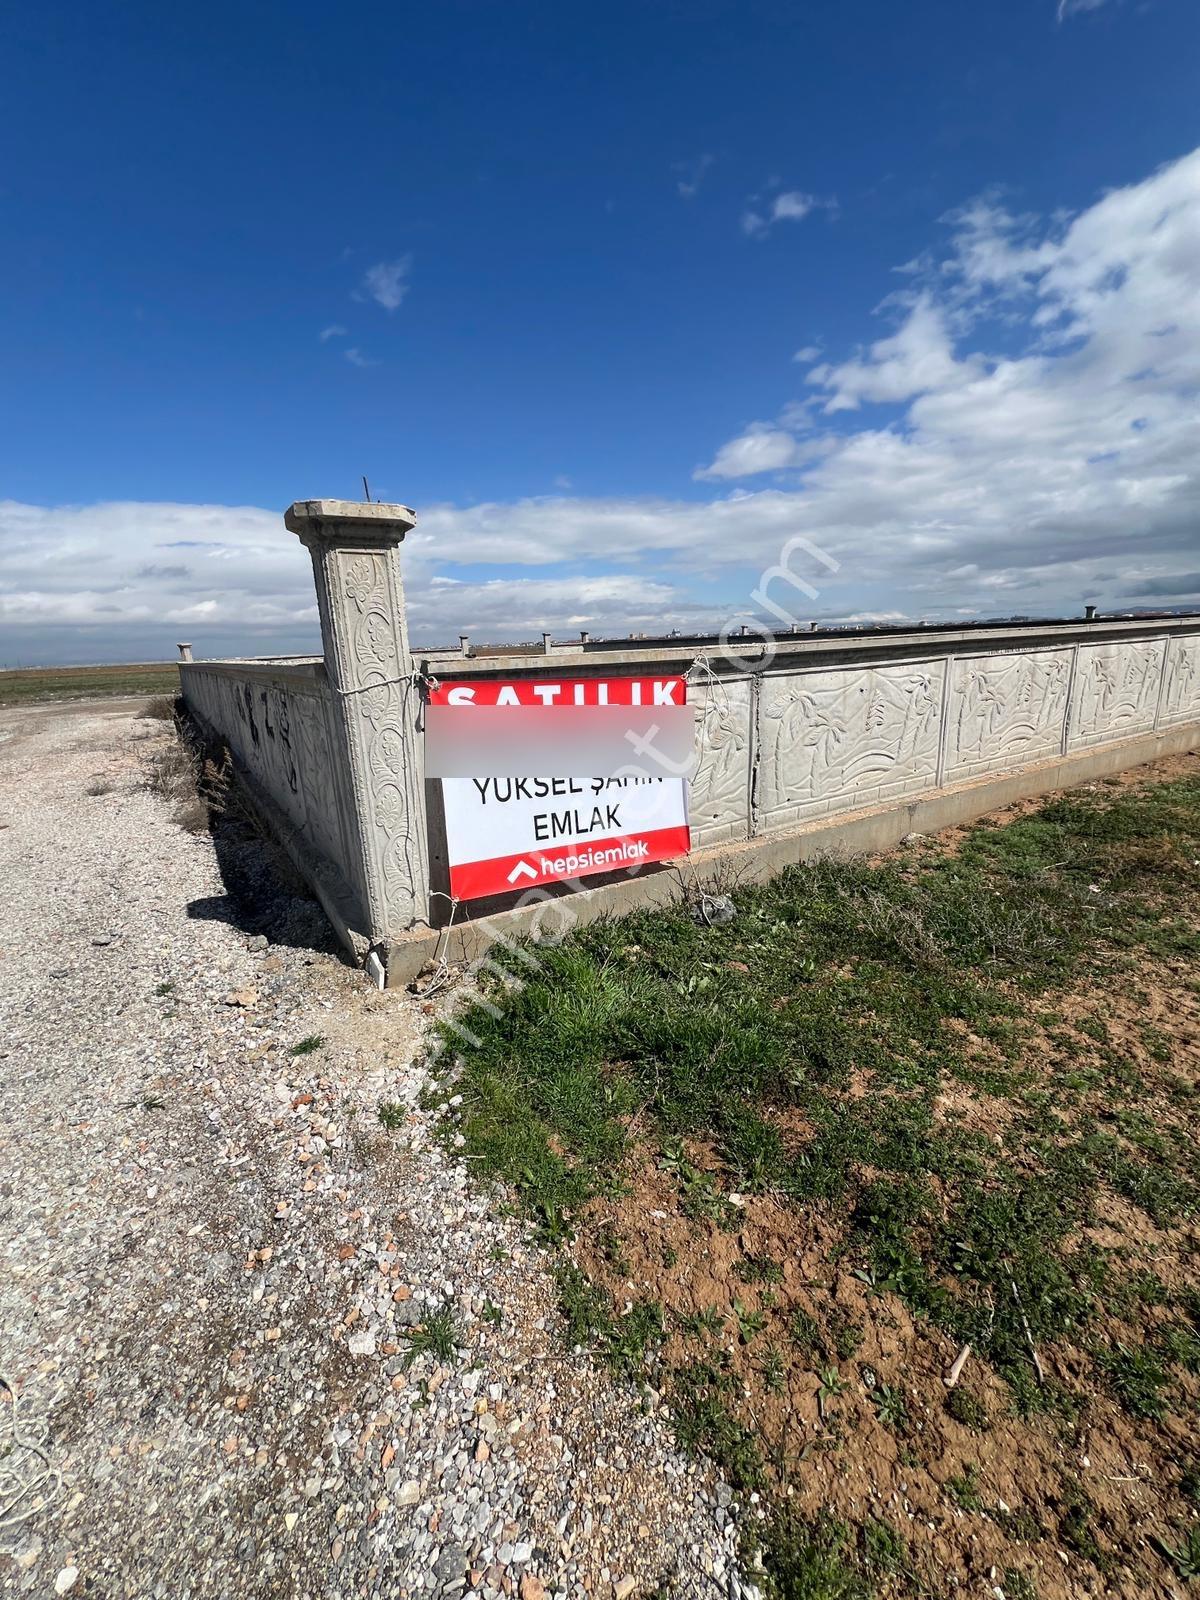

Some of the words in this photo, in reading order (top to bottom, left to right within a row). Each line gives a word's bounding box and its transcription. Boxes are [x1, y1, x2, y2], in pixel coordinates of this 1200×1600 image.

[447, 681, 678, 705] SATILIK
[533, 804, 622, 841] EMLAK
[540, 840, 649, 876] hepsiemlak
